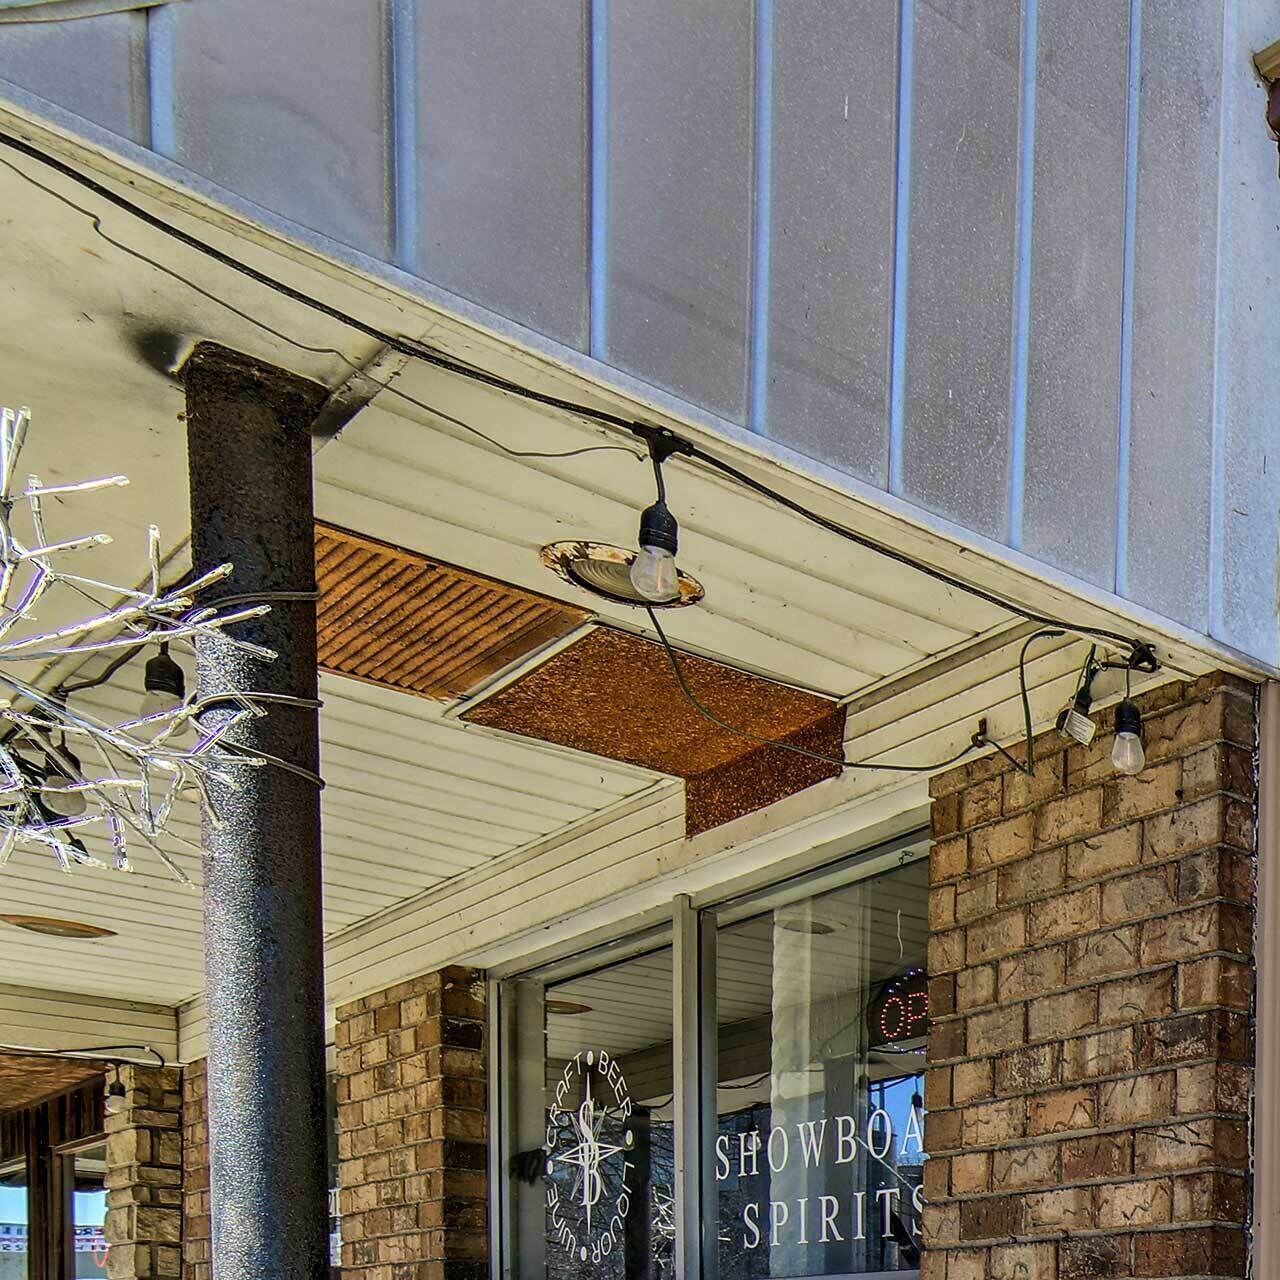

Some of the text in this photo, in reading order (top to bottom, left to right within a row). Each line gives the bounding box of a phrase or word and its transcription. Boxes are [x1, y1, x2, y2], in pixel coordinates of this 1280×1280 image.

[546, 1050, 633, 1148] CRAFT BEER
[546, 1183, 577, 1258] WINE
[591, 1161, 635, 1263] LIQUOR
